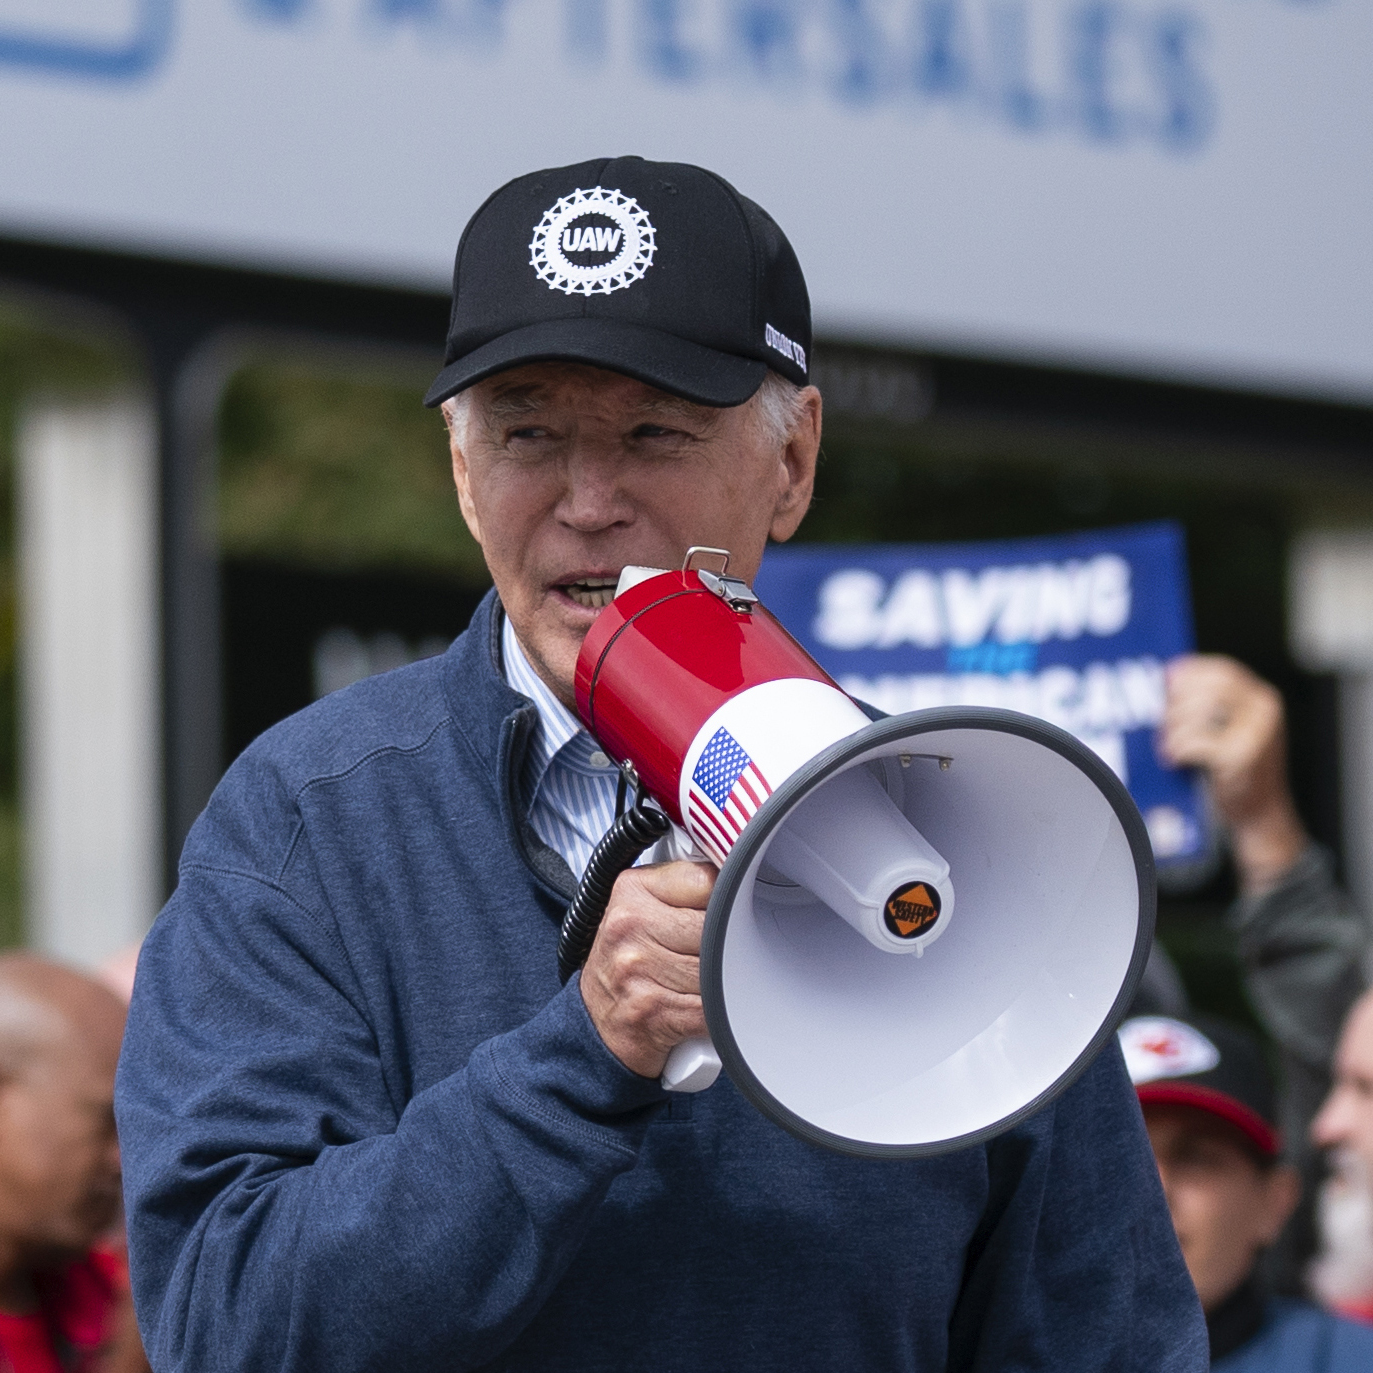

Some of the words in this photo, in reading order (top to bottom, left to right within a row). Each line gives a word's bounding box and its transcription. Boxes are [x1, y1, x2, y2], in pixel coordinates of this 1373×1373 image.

[352, 0, 1219, 158] ERSALES
[562, 227, 622, 252] UAW
[814, 552, 1132, 650] SAVING
[892, 899, 935, 917] WESTERN
